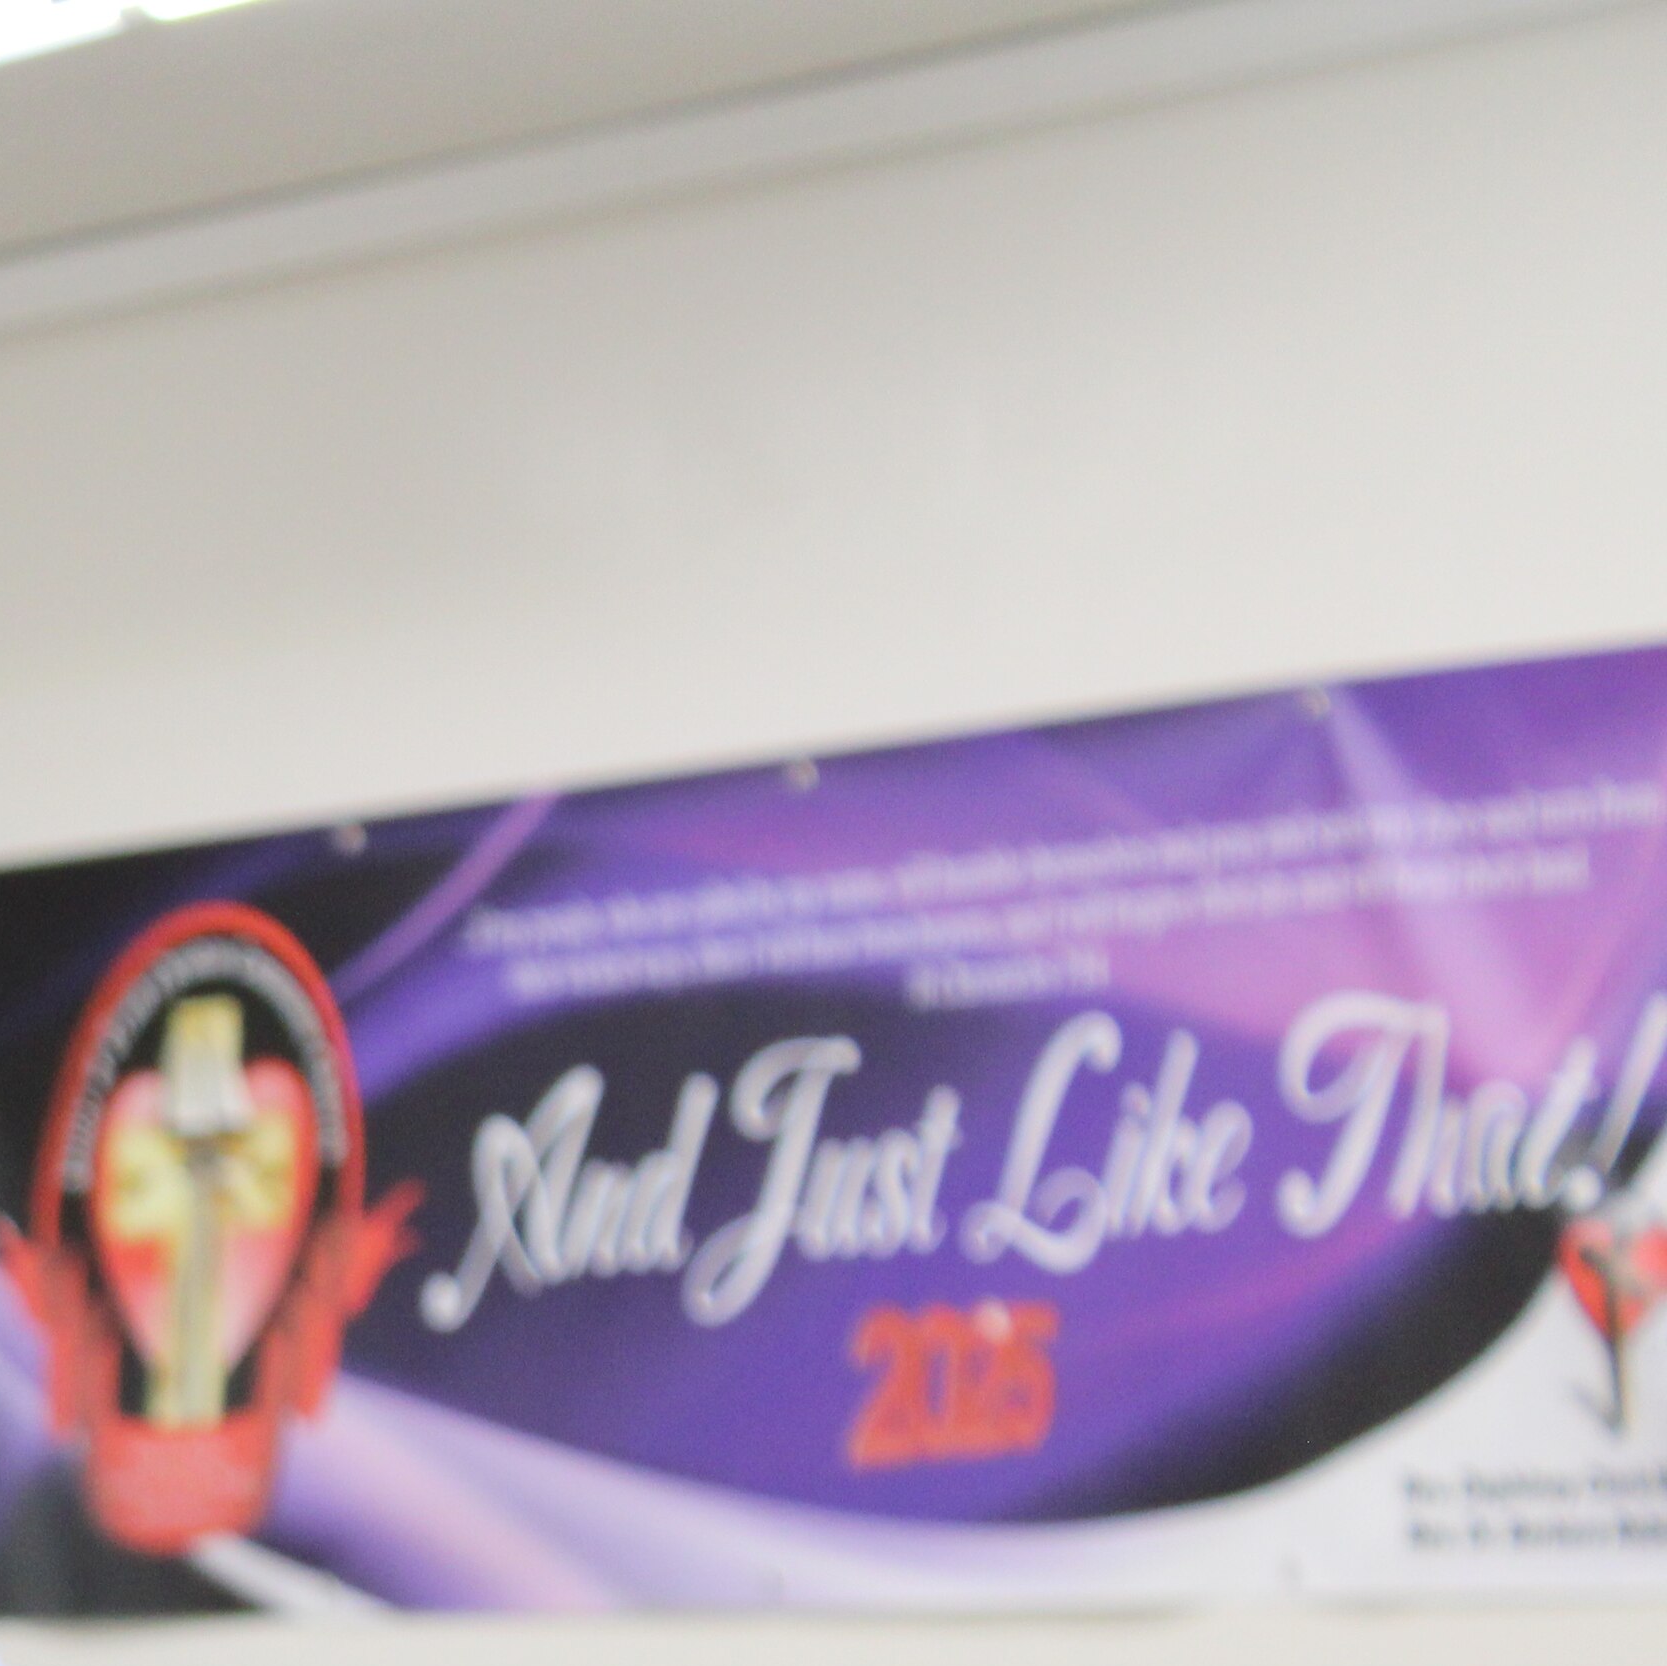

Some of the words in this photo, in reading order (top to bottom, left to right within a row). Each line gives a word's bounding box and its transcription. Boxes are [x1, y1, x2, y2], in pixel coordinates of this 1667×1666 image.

[420, 1064, 719, 1333] And
[682, 1034, 962, 1327] Just
[960, 1009, 1254, 1276] Like
[846, 1298, 1058, 1473] 2025
